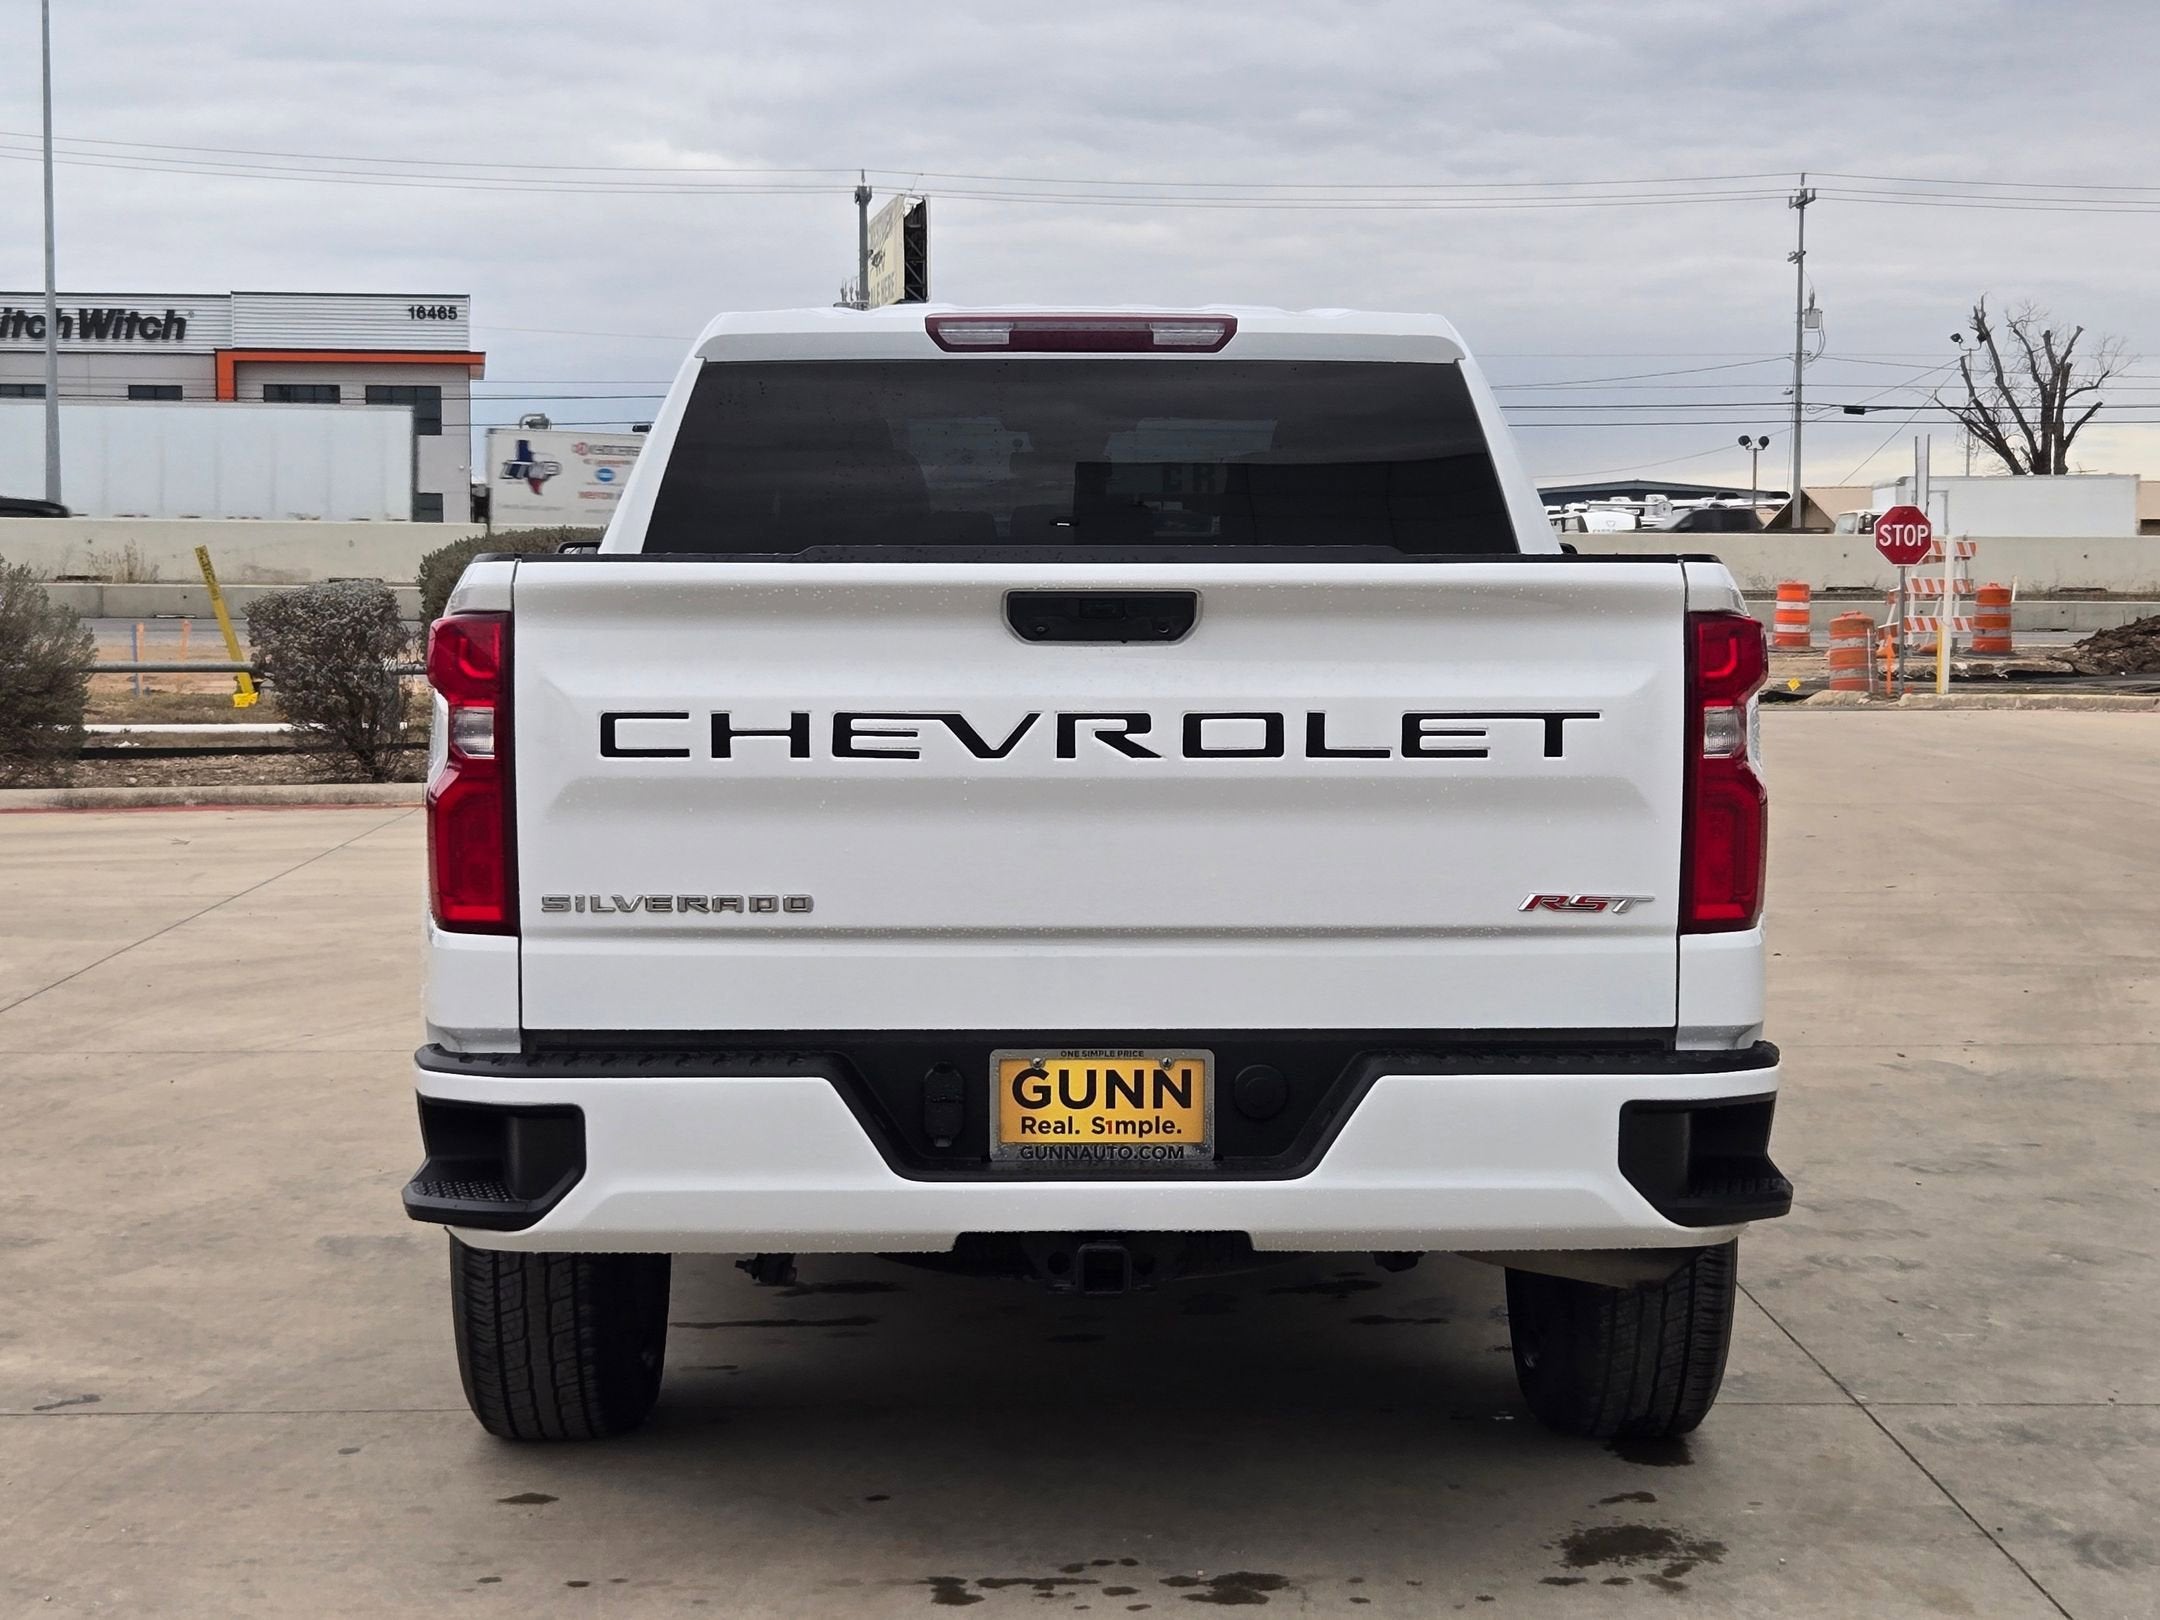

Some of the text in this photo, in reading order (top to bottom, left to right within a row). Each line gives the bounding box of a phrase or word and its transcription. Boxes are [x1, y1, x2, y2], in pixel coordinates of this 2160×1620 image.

[408, 305, 458, 320] 16465
[1879, 524, 1929, 547] STOP
[600, 711, 1600, 759] CHEVROLET
[541, 895, 815, 913] SILVERADO
[1518, 893, 1656, 915] RST
[1060, 1050, 1144, 1058] ONE SIMPLE PRICE
[1011, 1068, 1192, 1110] GUNN
[1021, 1116, 1080, 1135] Real.
[1020, 1146, 1185, 1160] GUNNAUTO.COM
